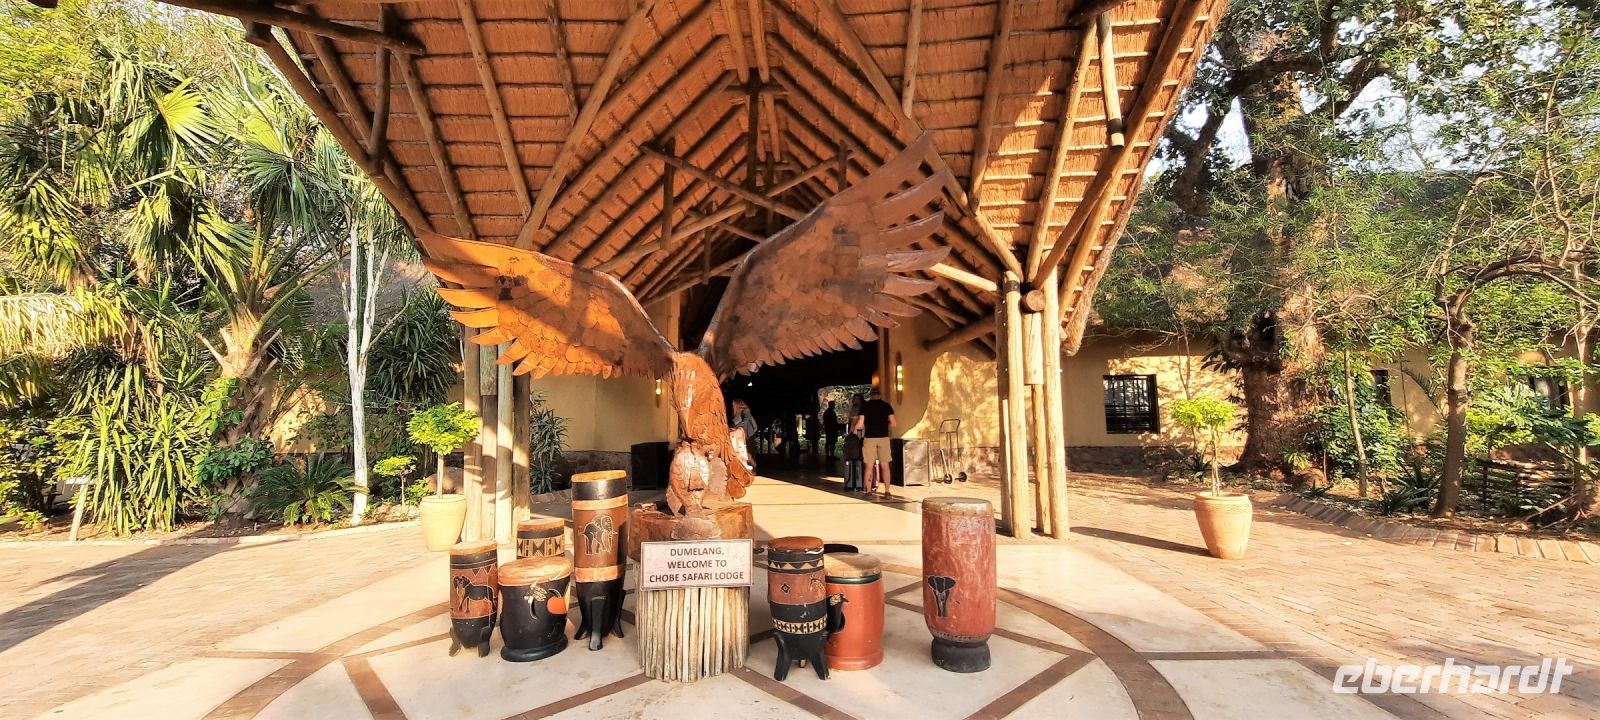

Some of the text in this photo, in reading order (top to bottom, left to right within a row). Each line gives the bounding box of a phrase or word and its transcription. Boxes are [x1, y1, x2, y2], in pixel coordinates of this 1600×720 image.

[670, 548, 725, 556] DUMELANG,
[667, 560, 712, 569] WELCOME
[649, 571, 744, 582] CHOBE SAFARI LODGE
